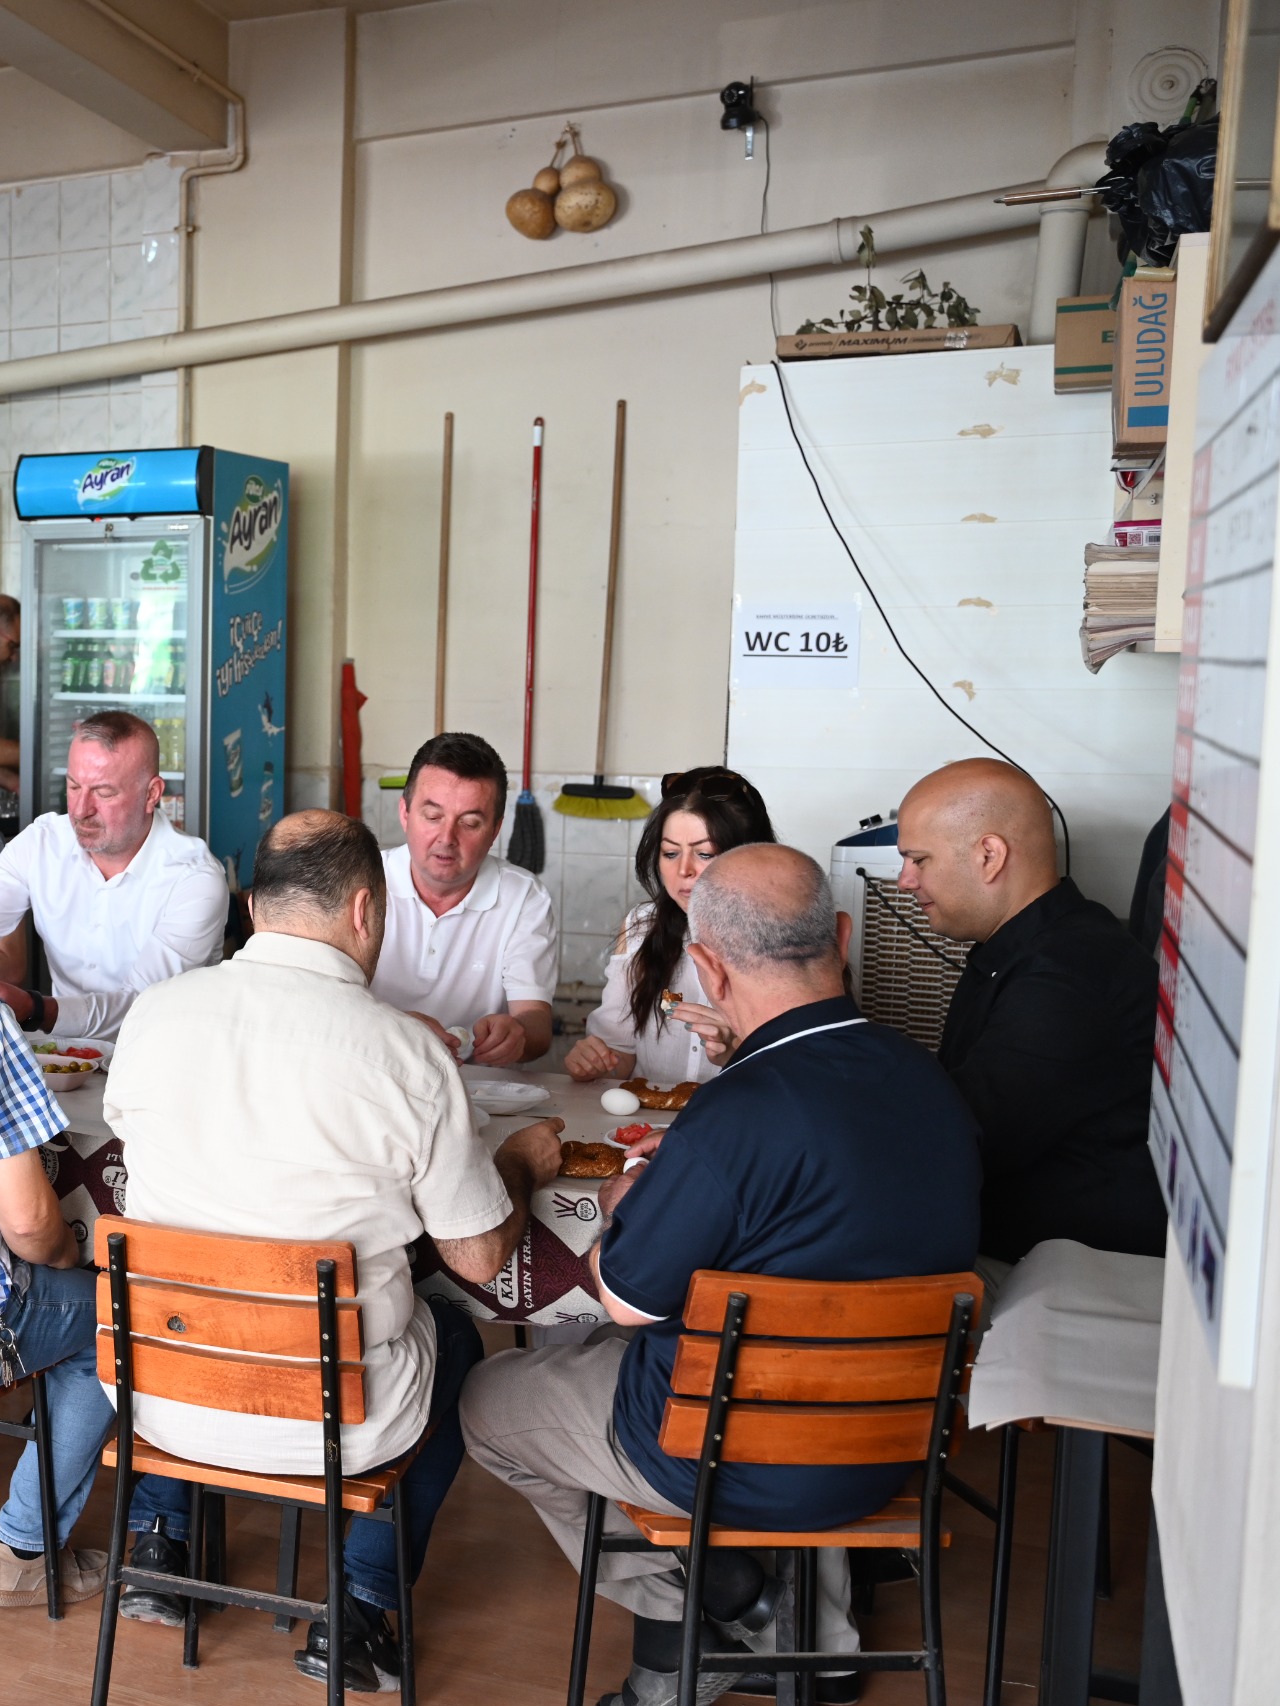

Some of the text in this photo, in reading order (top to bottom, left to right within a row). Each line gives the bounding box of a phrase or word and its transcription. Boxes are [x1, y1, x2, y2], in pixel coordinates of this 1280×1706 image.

[838, 336, 909, 347] MAXIMUM
[1132, 293, 1168, 397] ULUDAĞ
[82, 462, 131, 493] Ayran
[230, 495, 279, 555] Ayran
[744, 631, 791, 652] WC
[523, 1270, 535, 1309] ÇAYIN
